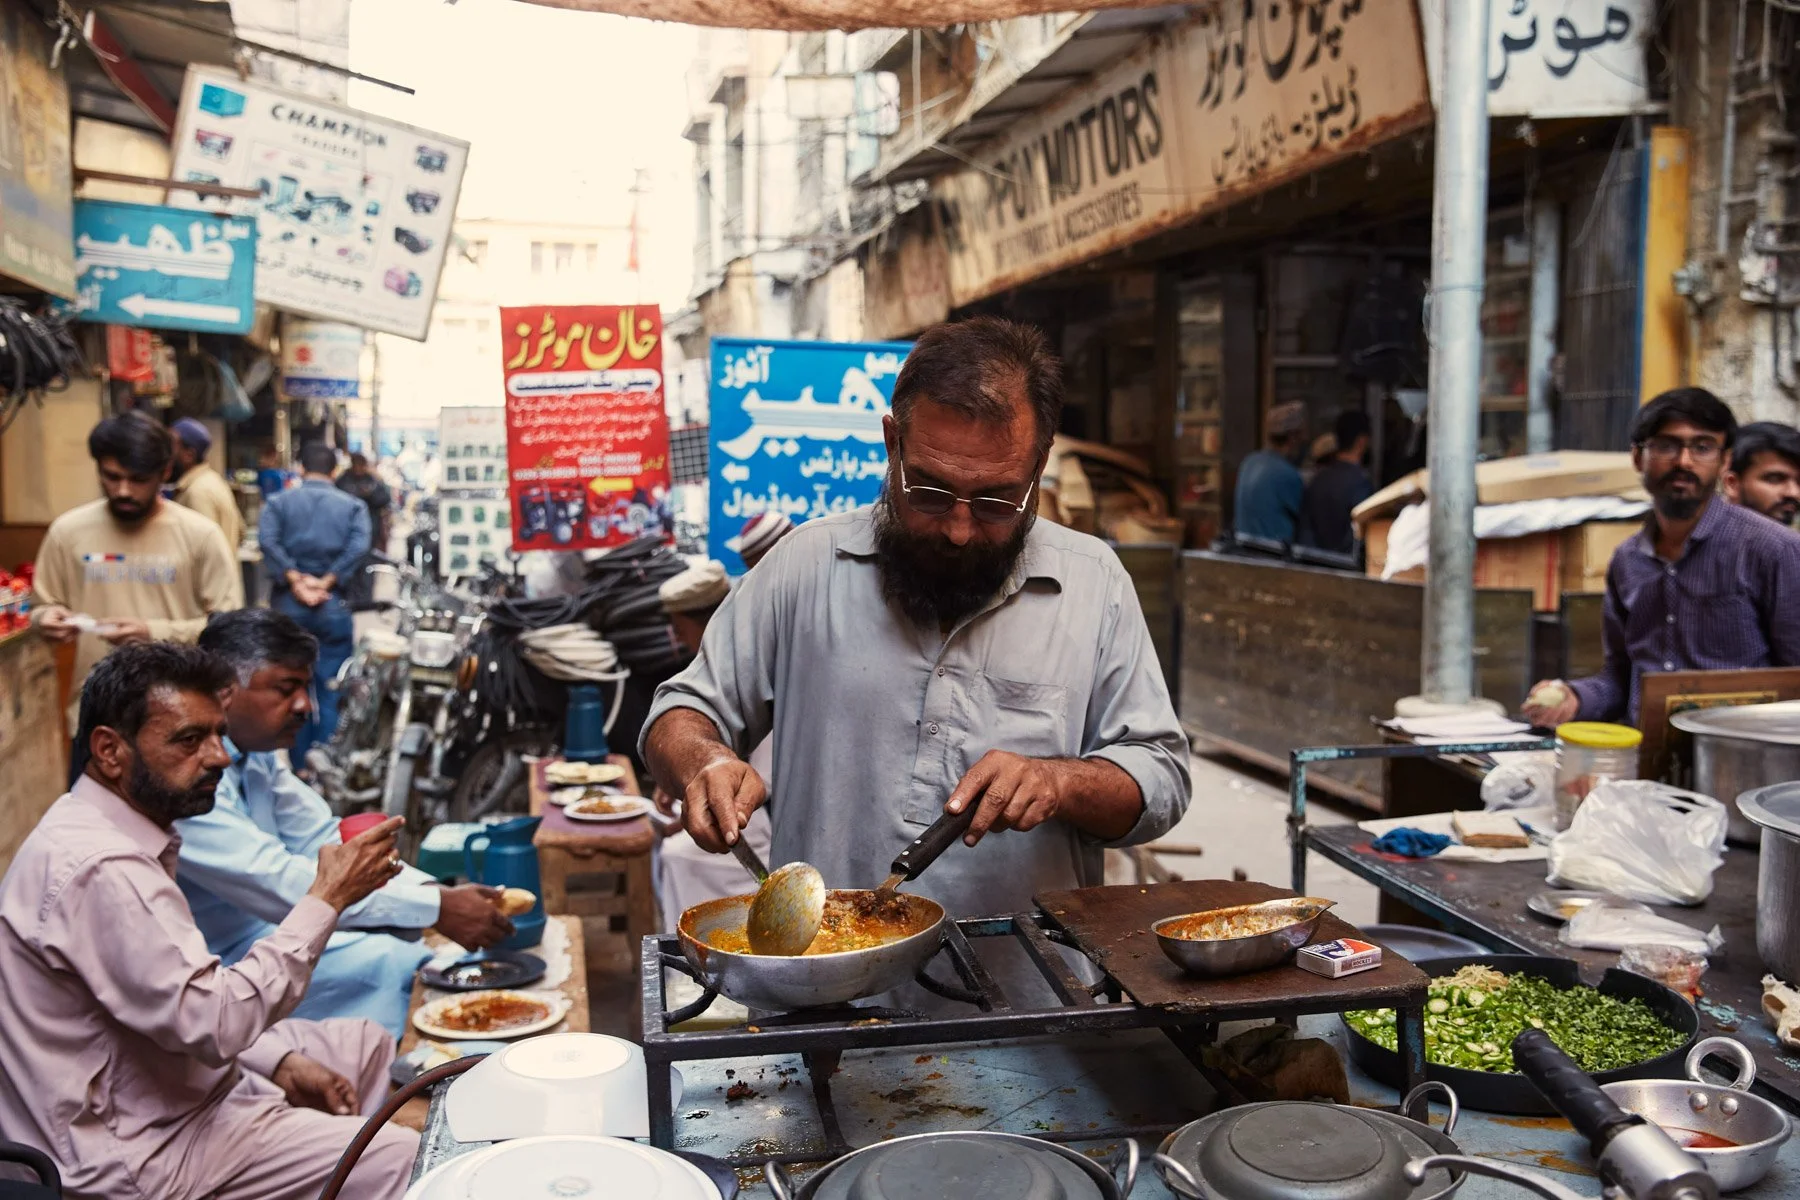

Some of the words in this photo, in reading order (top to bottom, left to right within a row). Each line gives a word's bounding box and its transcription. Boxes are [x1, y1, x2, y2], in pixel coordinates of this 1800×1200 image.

[270, 103, 387, 147] CHAMPION
[1040, 71, 1164, 208] MOTORS
[506, 311, 586, 370] موٹرز
[581, 307, 659, 370] خان
[718, 345, 775, 389] آٹوز
